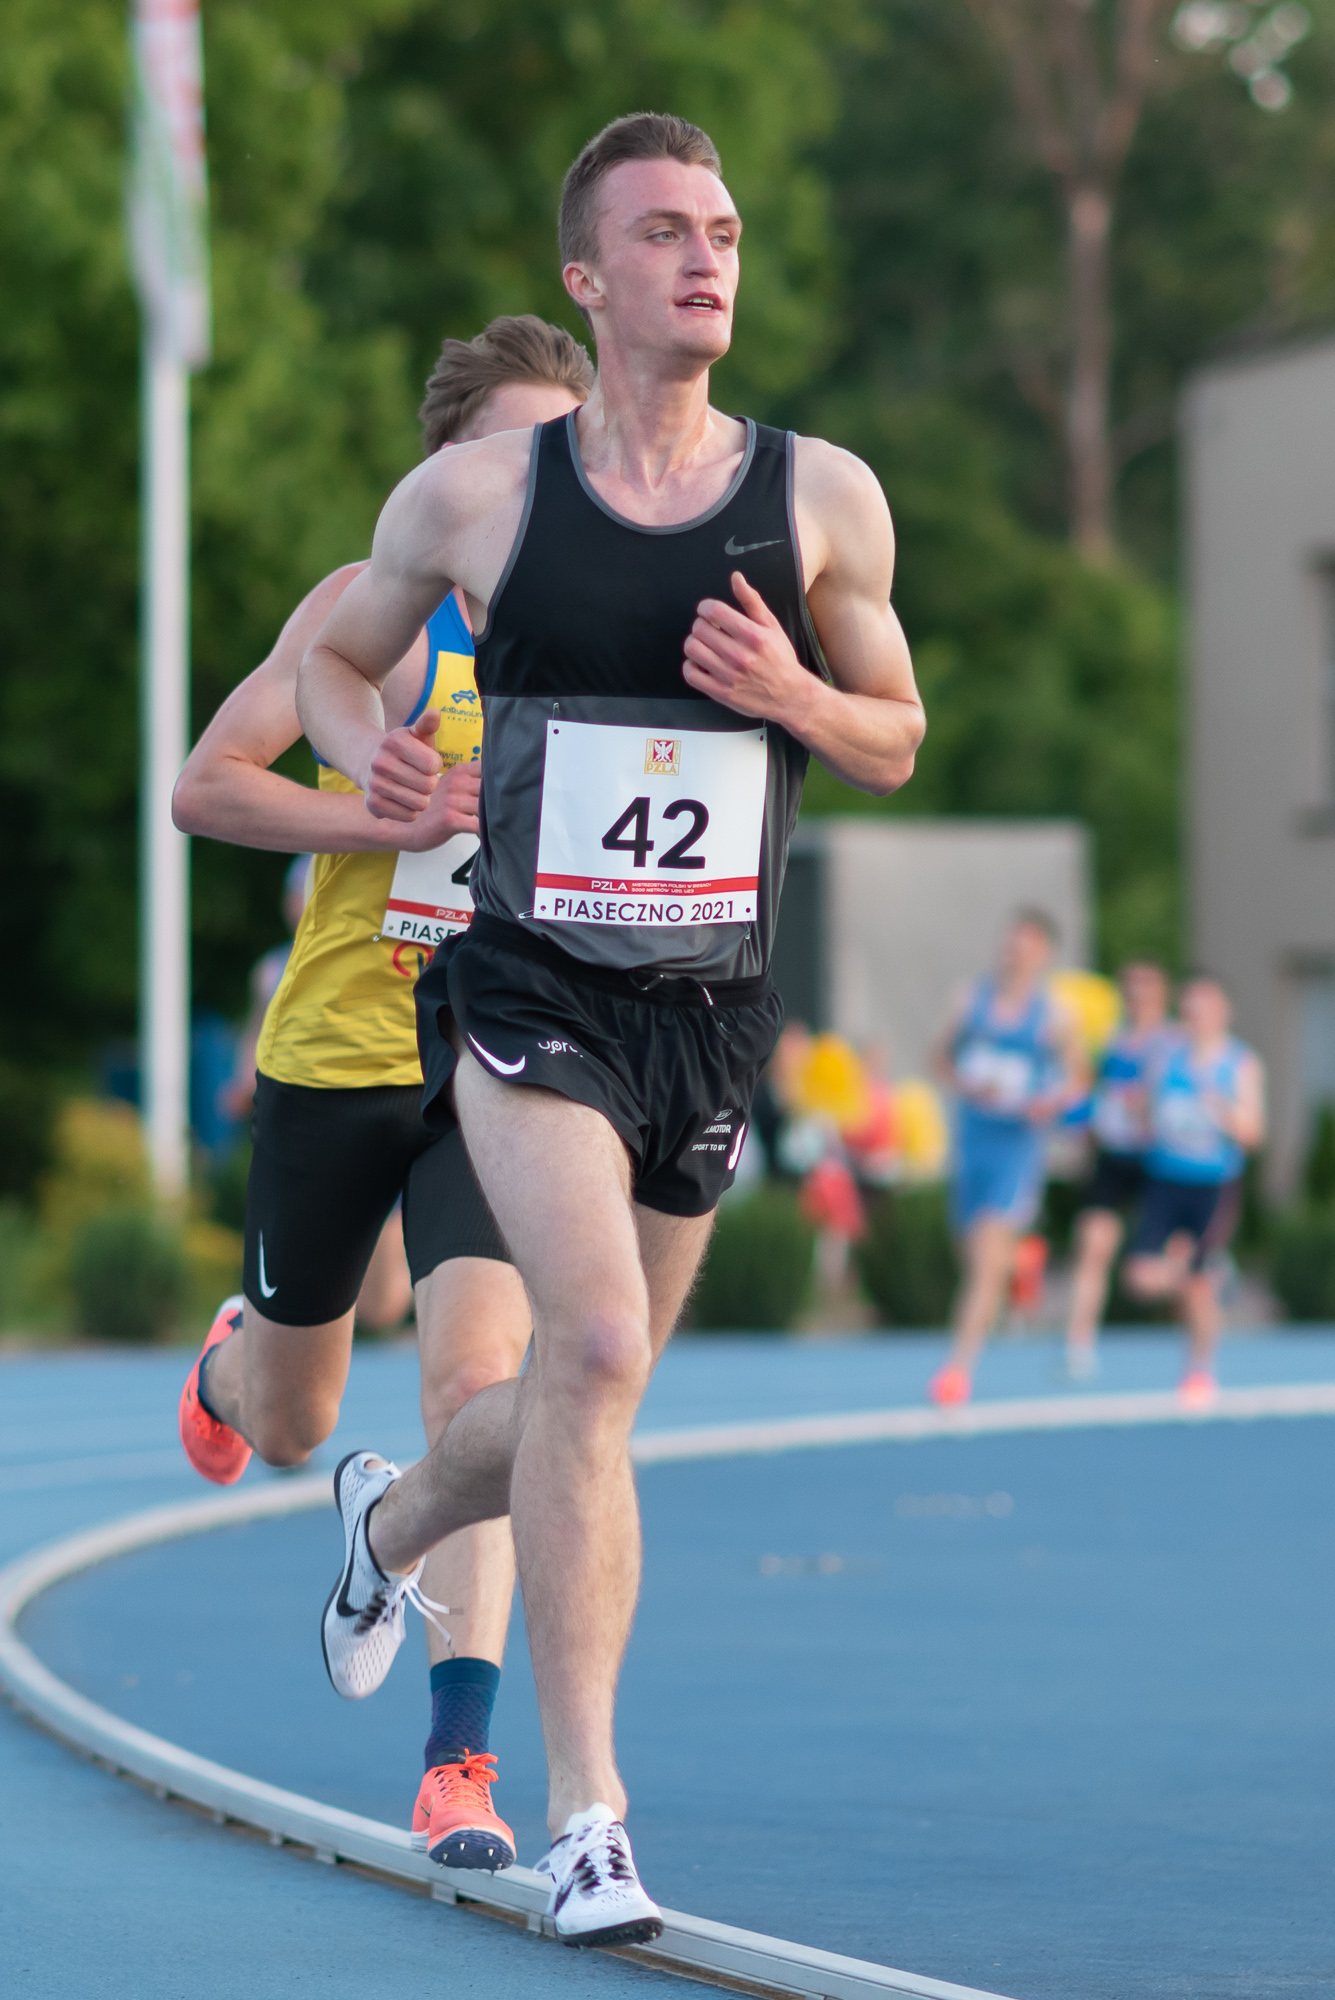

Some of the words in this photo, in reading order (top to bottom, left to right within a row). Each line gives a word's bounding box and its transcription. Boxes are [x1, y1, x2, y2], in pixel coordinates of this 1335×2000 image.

[646, 763, 677, 774] PZLA
[601, 796, 710, 869] 42
[591, 880, 628, 892] PZLA
[435, 908, 469, 922] PZLA
[554, 897, 684, 922] PIASECZNO
[689, 900, 734, 921] 2021
